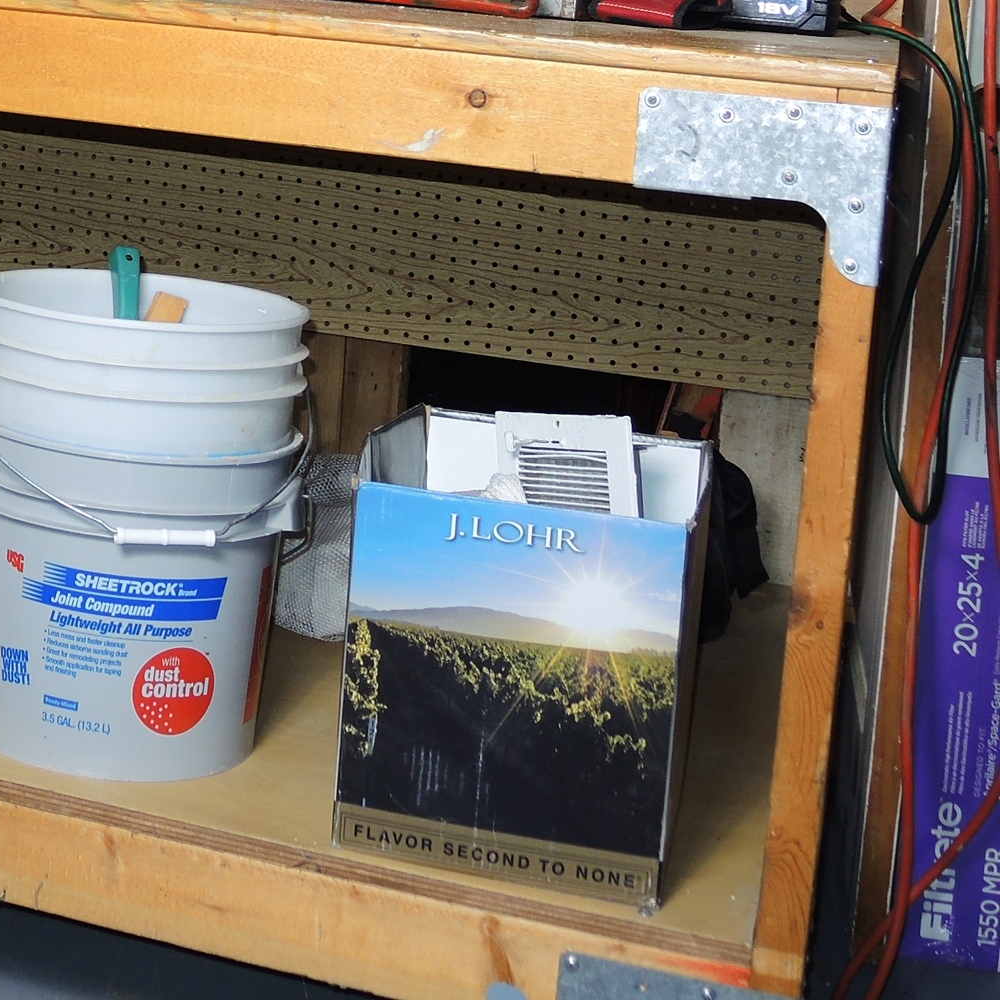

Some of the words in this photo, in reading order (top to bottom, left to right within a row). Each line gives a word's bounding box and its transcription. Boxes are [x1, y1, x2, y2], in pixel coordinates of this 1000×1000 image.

[757, 1, 798, 15] 18V
[6, 549, 24, 573] USG
[74, 572, 178, 596] SHEETROCK
[51, 591, 83, 608] Joint
[86, 597, 155, 618] Compound
[49, 610, 123, 635] Lightweight
[123, 625, 141, 636] All
[143, 624, 193, 640] Purpose
[47, 629, 59, 637] Less
[104, 640, 126, 649] cleanup
[47, 638, 69, 649] Reduces
[93, 648, 114, 658] sanding
[116, 650, 128, 658] dust
[1, 646, 29, 662] DOWN
[69, 653, 99, 665] remodeling
[99, 658, 122, 667] projects
[162, 656, 180, 667] with
[2, 656, 27, 673] WITH
[45, 655, 65, 666] Smooth
[66, 661, 94, 672] application
[104, 668, 121, 677] taping
[55, 666, 76, 678] finishing
[144, 667, 180, 682] dust
[1, 670, 30, 685] DUST!
[141, 677, 209, 698] control
[41, 711, 55, 723] 3.5
[56, 715, 75, 728] GAL.
[77, 720, 100, 733] (13.2
[101, 723, 111, 735] L)
[353, 825, 434, 852] FLAVOR
[443, 843, 531, 870] SECOND
[539, 858, 566, 876] TO
[575, 866, 636, 889] NONE
[982, 848, 1000, 895] MPR
[977, 900, 999, 946] 1550
